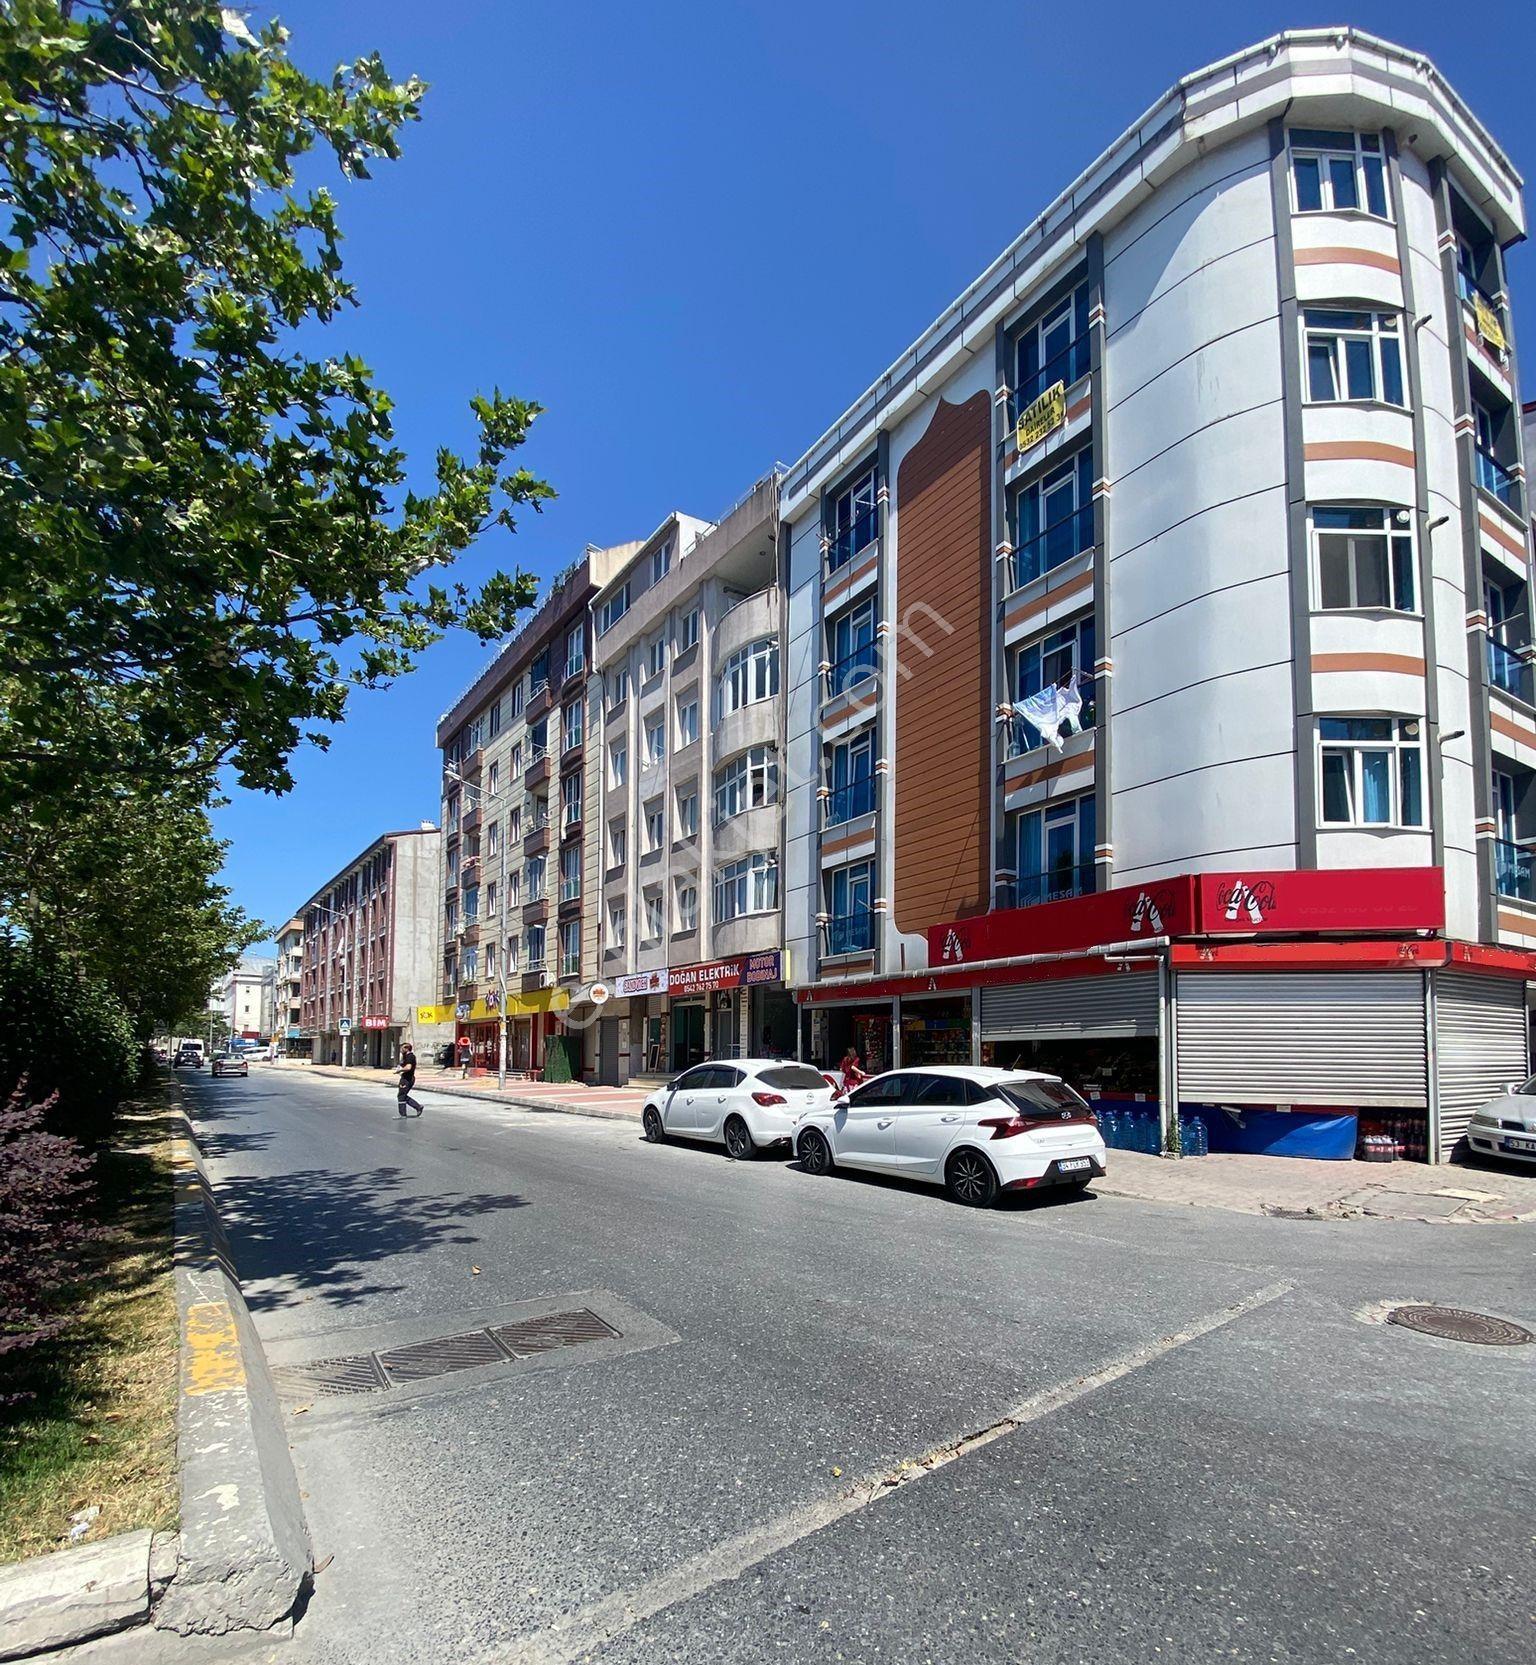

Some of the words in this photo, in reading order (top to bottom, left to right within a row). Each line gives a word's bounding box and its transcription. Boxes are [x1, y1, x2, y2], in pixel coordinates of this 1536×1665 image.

[1018, 385, 1061, 430] SATILIK
[749, 955, 775, 970] MOTOR
[669, 970, 697, 986] DOĞAN
